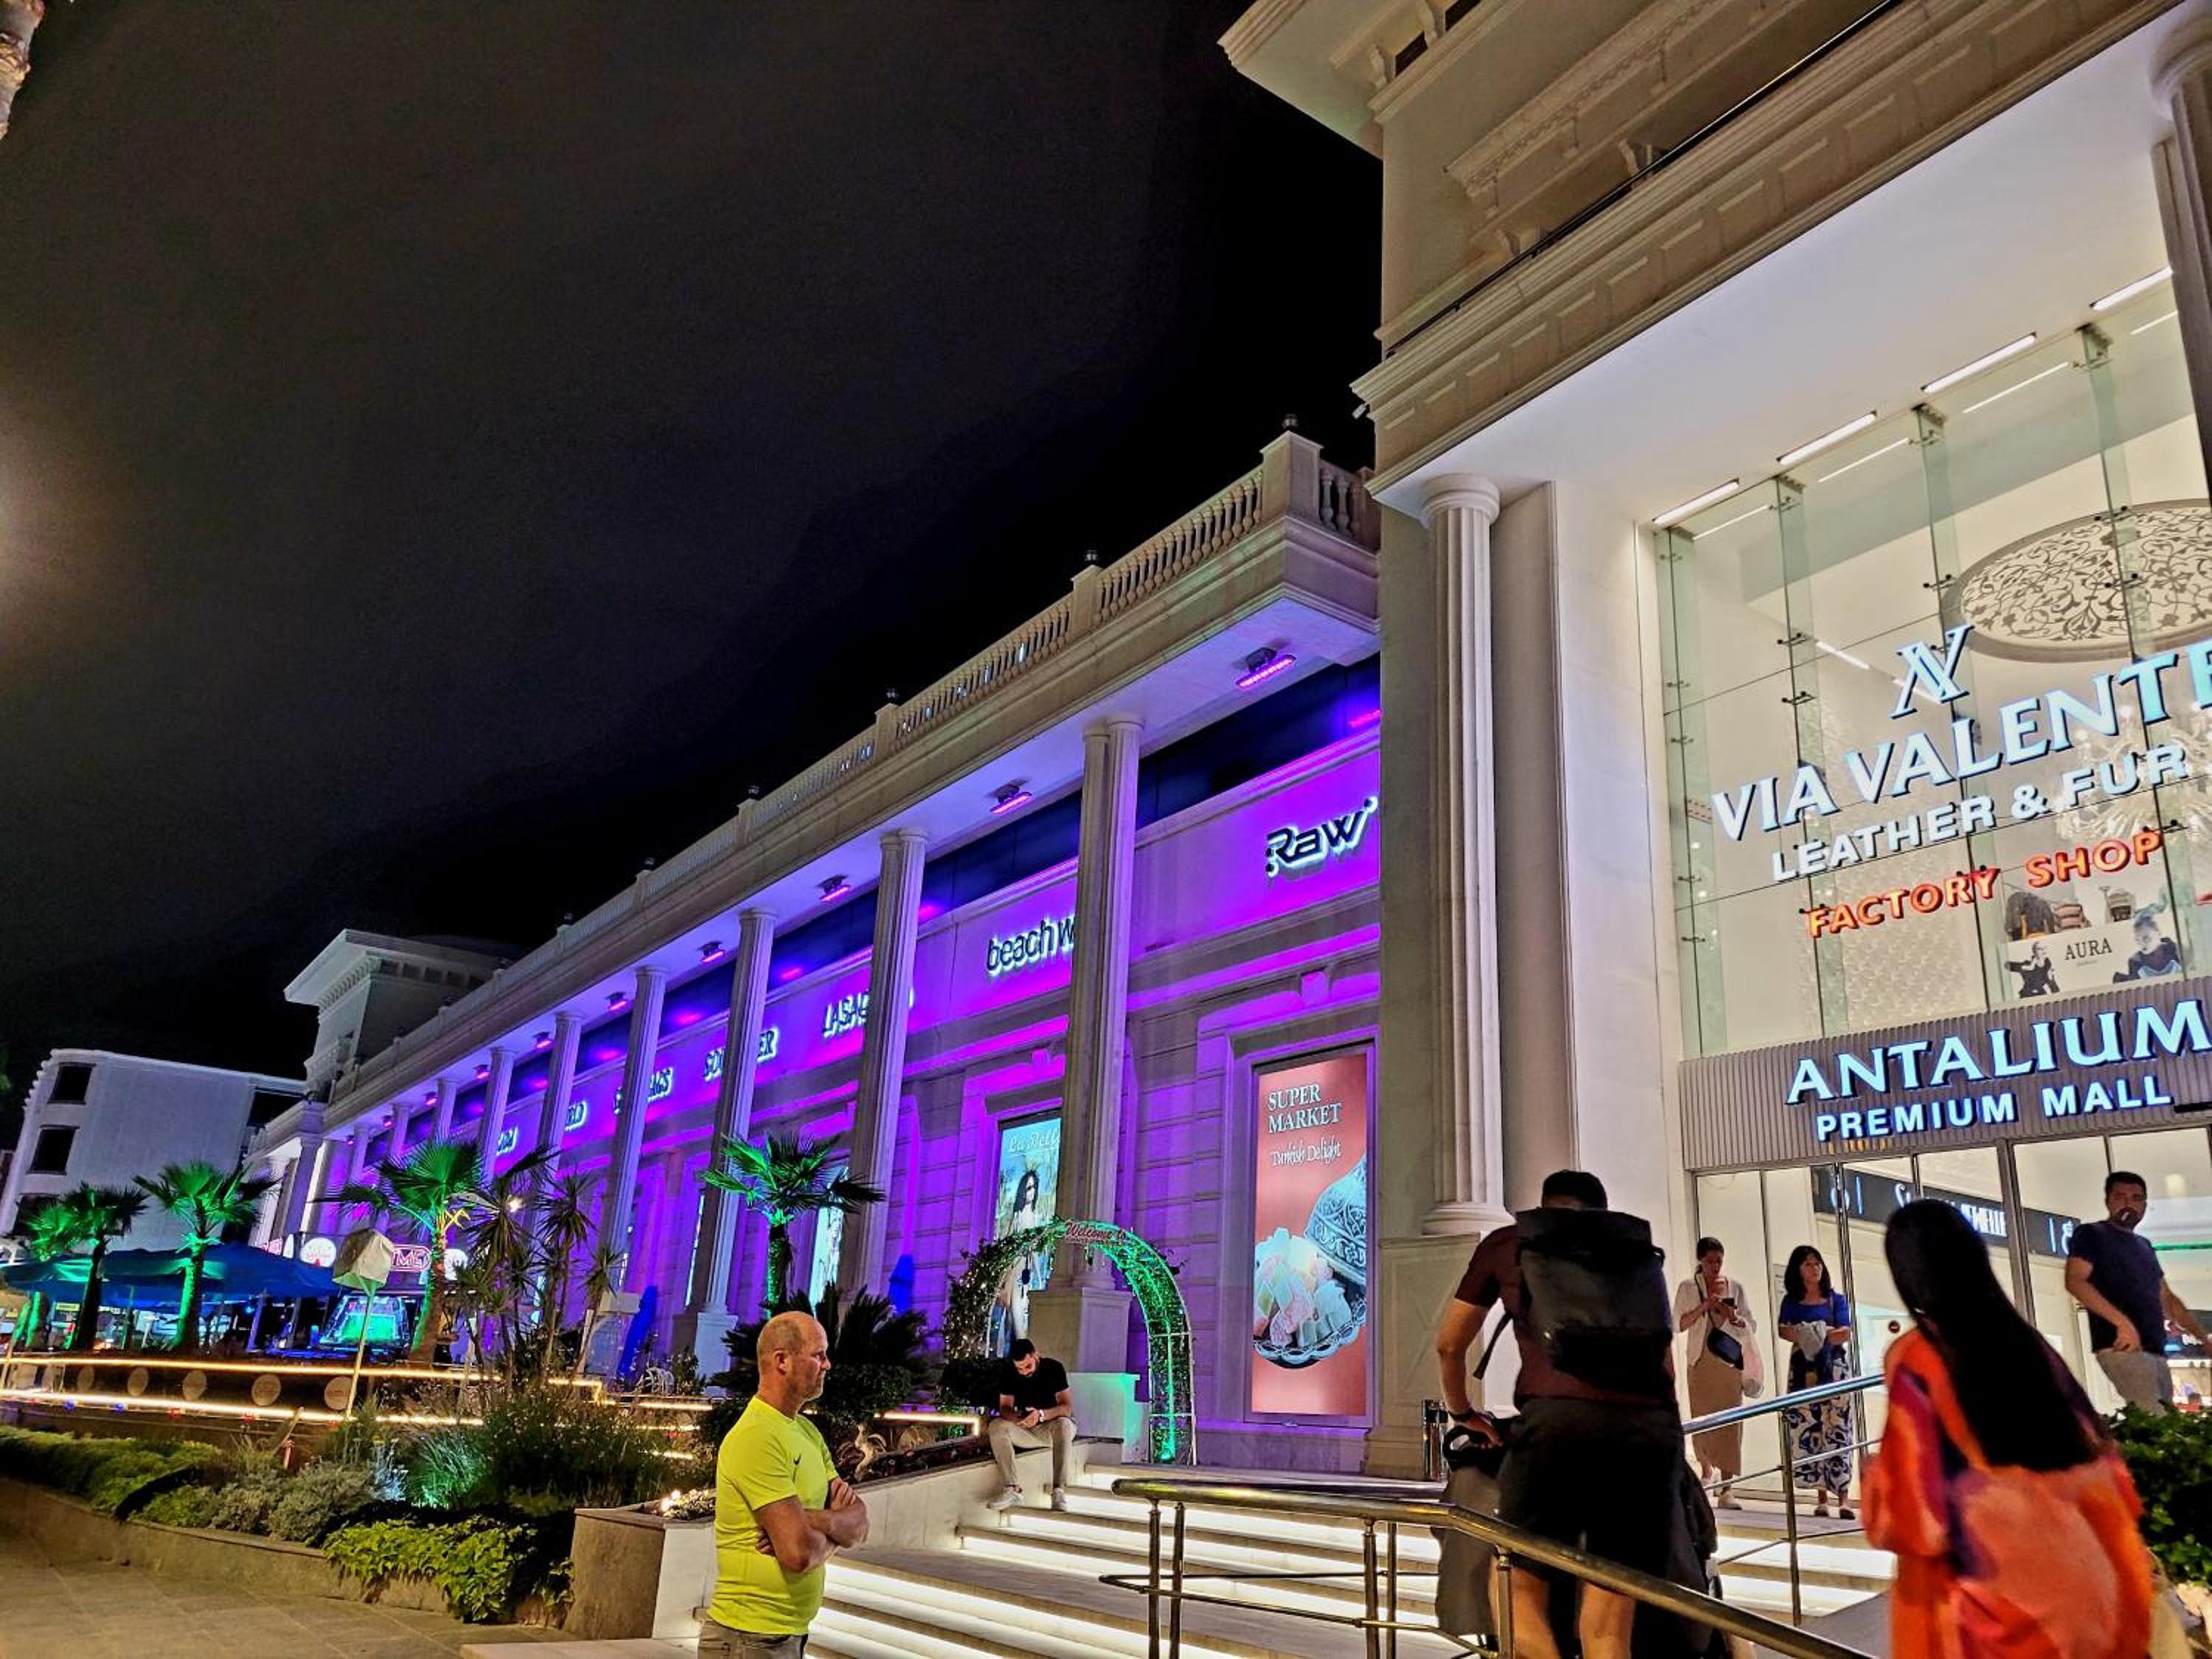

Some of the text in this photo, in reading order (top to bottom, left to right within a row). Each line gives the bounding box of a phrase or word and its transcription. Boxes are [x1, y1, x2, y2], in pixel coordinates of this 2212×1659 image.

[1711, 763, 1841, 842] VIA
[1772, 742, 2190, 883] LEATHER & FUR
[1806, 830, 2165, 939] FACTORY SHOP
[2065, 937, 2112, 960] AURA
[1784, 998, 2212, 1106] ANTALIUM
[1267, 1083, 1322, 1111] SUPER
[1268, 1102, 1343, 1134] MARKET
[1816, 1074, 2174, 1143] PREMIUM MALL
[1270, 1136, 1340, 1166] Turkish Delight
[1065, 1222, 1113, 1239] Welcome
